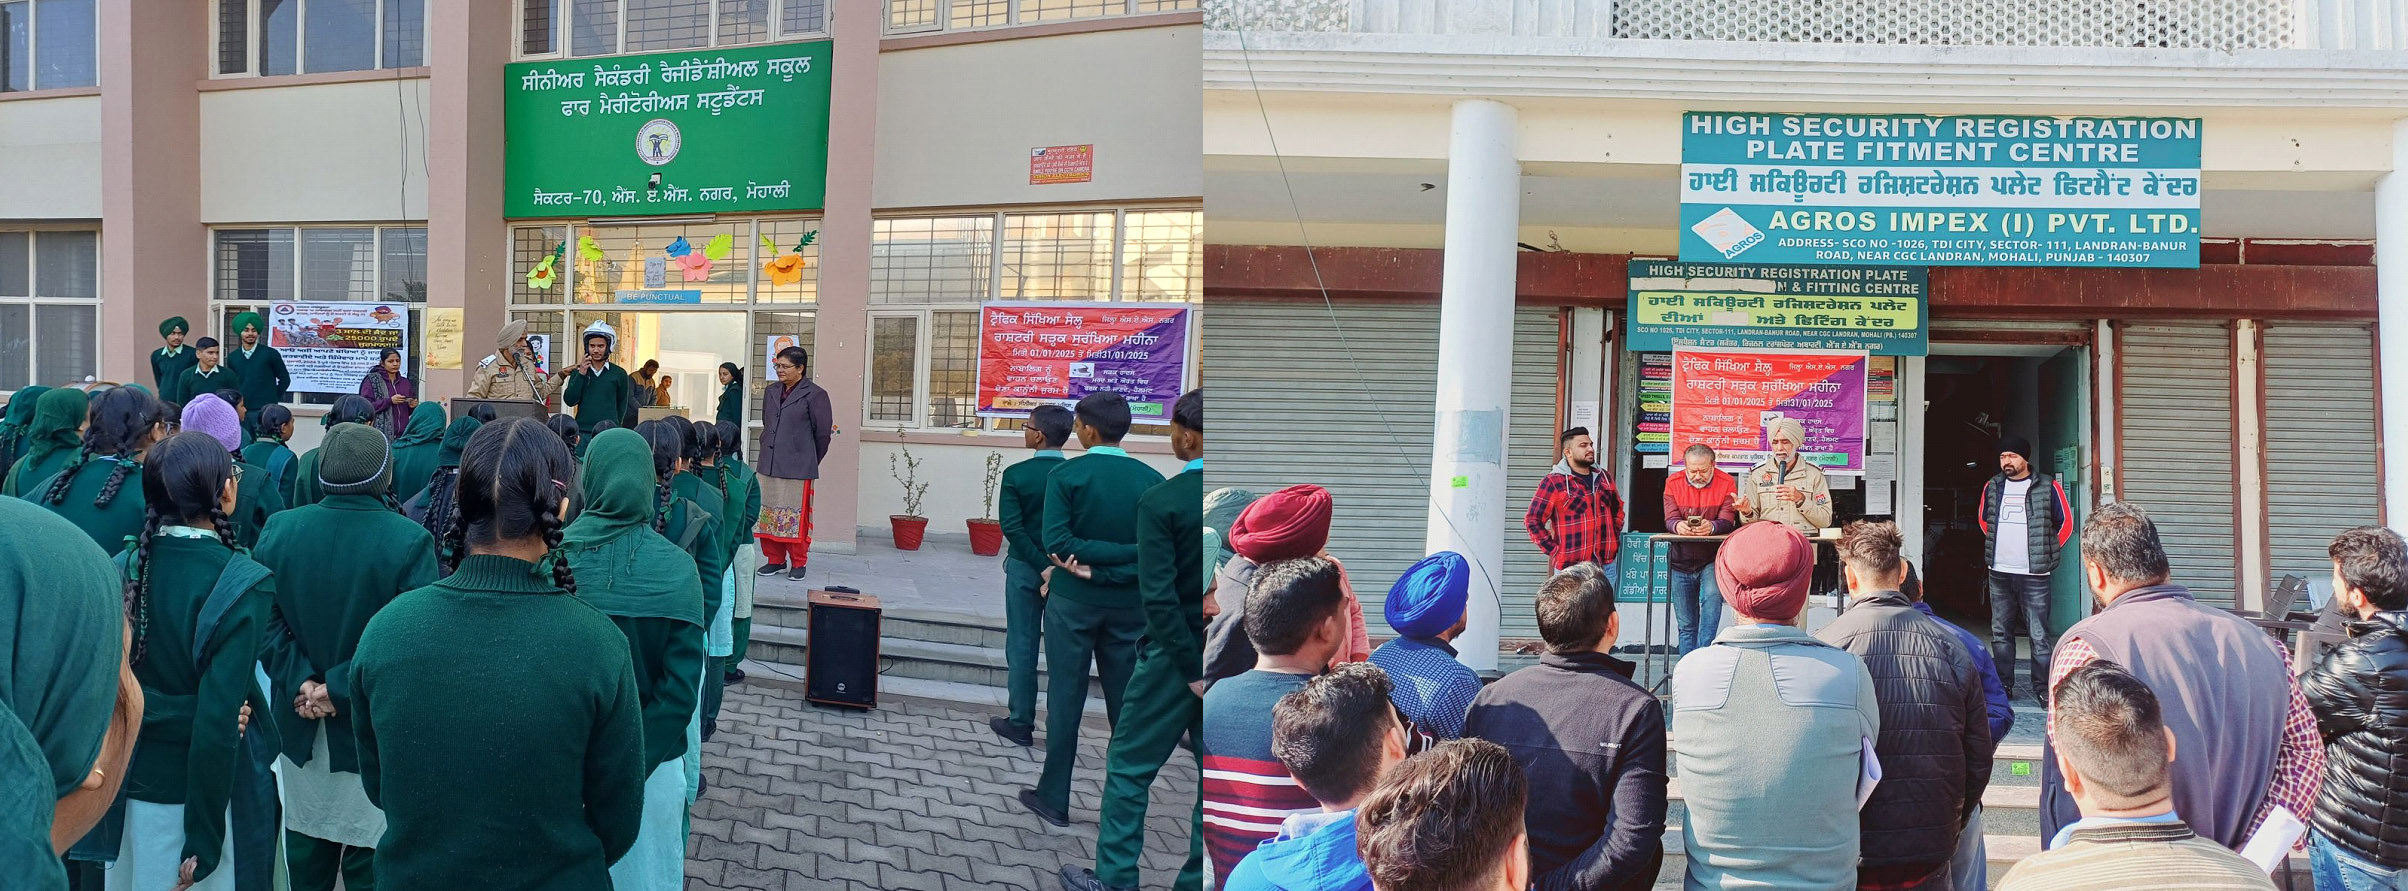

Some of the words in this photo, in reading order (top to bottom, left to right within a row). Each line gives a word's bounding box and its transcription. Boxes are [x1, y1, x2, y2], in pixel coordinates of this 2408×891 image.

[522, 69, 584, 91] ਸੀਨੀਅਰ
[594, 63, 651, 87] ਸੈਕੰਡਰੀ
[659, 57, 759, 84] ਰੈਜੀਡੈਂਸ਼ੀਅਲ
[767, 56, 812, 82] ਸਕੂਲ
[561, 99, 591, 117] ਫਾਰ
[600, 90, 689, 115] ਮੈਰੀਟੋਰੀਅਸ
[697, 84, 765, 116] ਸਟੂਡੈਂਟਸ
[1691, 115, 1770, 136] HIGH
[1782, 116, 1944, 138] SECURITY
[1955, 118, 2197, 139] REGISTRATION
[1747, 140, 1845, 161] PLATE
[1857, 141, 1998, 162] FITMENT
[2009, 143, 2139, 163] CENTRE
[700, 187, 738, 203] ਨਗਰ,
[746, 180, 791, 199] ਮੋਹਾਲੀ
[1689, 168, 1739, 192] ਹਾਈ
[1750, 168, 1847, 203] ਸਕਿਊਰਟੀ
[1991, 170, 2042, 196] ਪਲੇਟ
[2142, 171, 2198, 196] ਕੇਂਦਰ
[1768, 210, 1877, 232] AGROS
[1890, 212, 1989, 233] IMPEX
[2001, 212, 2034, 238] (I)
[2048, 213, 2116, 234] PVT.
[2129, 213, 2198, 234] LTD.
[1725, 232, 1763, 257] AGROS
[1778, 238, 1840, 248] ADDRESS-
[1842, 238, 1866, 248] SCO
[1869, 238, 1888, 248] NO
[1892, 239, 1929, 251] -1026,
[1932, 239, 1952, 249] TDI
[1955, 239, 1987, 251] CITY,
[1990, 240, 2042, 250] SECTOR-
[2046, 240, 2072, 251] 111,
[2075, 241, 2187, 251] LANDRAN-BANUR
[1816, 251, 1854, 262] ROAD,
[1857, 251, 1890, 260] NEAR
[1893, 251, 1917, 261] CGC
[1920, 252, 1985, 263] LANDRAN,
[1988, 252, 2042, 263] MOHALI,
[2046, 253, 2095, 263] PUNJAB
[2107, 253, 2151, 263] 140307
[1649, 265, 1683, 276] HIGH
[1688, 265, 1758, 278] SECURITY
[1761, 267, 1860, 280] REGISTRATION
[1866, 270, 1908, 281] PLATE
[1792, 282, 1801, 292] &
[1806, 282, 1860, 293] FITTING
[1865, 283, 1919, 294] CENTRE
[641, 292, 686, 301] PUNCTUAL
[1648, 294, 1685, 307] ਹਾਈ
[1870, 299, 1907, 311] ਪਲੇਟ
[990, 311, 1018, 326] ਟ੍ਰੈਫਿਕ
[1023, 312, 1061, 325] ਸਿੱਖਿਆ
[1756, 313, 1786, 325] ਅਤੇ
[1855, 315, 1894, 327] ਕੇਂਦਰ
[994, 330, 1035, 343] ਰਾਸ਼ਟਰੀ
[1072, 332, 1118, 347] ਸੁਰੱਖਿਆ
[1123, 332, 1159, 346] ਮਹੀਨਾ
[1737, 328, 1783, 337] LANDRAN-BANUR
[1030, 349, 1075, 358] 01/01/2025
[1682, 357, 1711, 373] ਟ੍ਰੈਫਿਕ
[1715, 358, 1751, 371] ਸਿੱਖਿਆ
[1686, 377, 1726, 390] ਰਾਸ਼ਟਰੀ
[1762, 379, 1804, 394] ਸੁਰੱਖਿਆ
[1809, 379, 1841, 393] ਮਹੀਨਾ
[1722, 397, 1765, 406] 01/01/2025
